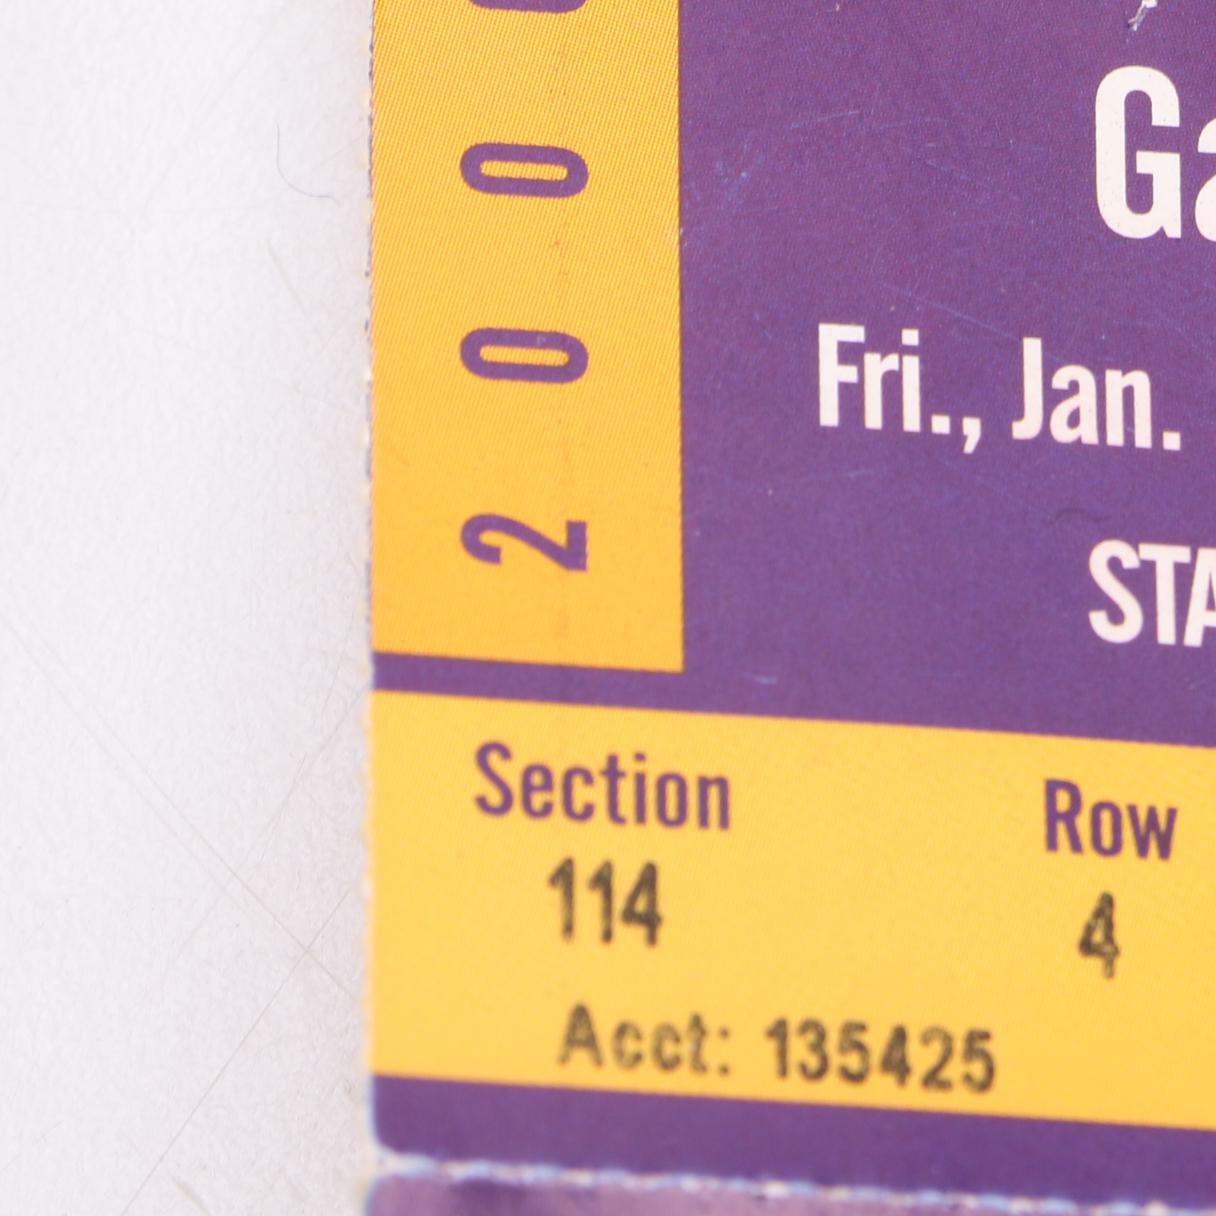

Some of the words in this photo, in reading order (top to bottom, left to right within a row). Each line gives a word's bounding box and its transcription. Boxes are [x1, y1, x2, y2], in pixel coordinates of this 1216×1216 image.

[818, 323, 983, 454] Fri.,
[1010, 337, 1182, 452] Jan.
[475, 741, 730, 831] Section
[1045, 779, 1179, 861] Row
[548, 857, 663, 947] 114
[1078, 891, 1121, 979] 4
[558, 1002, 732, 1076] Acct:
[765, 1018, 997, 1094] 135425
